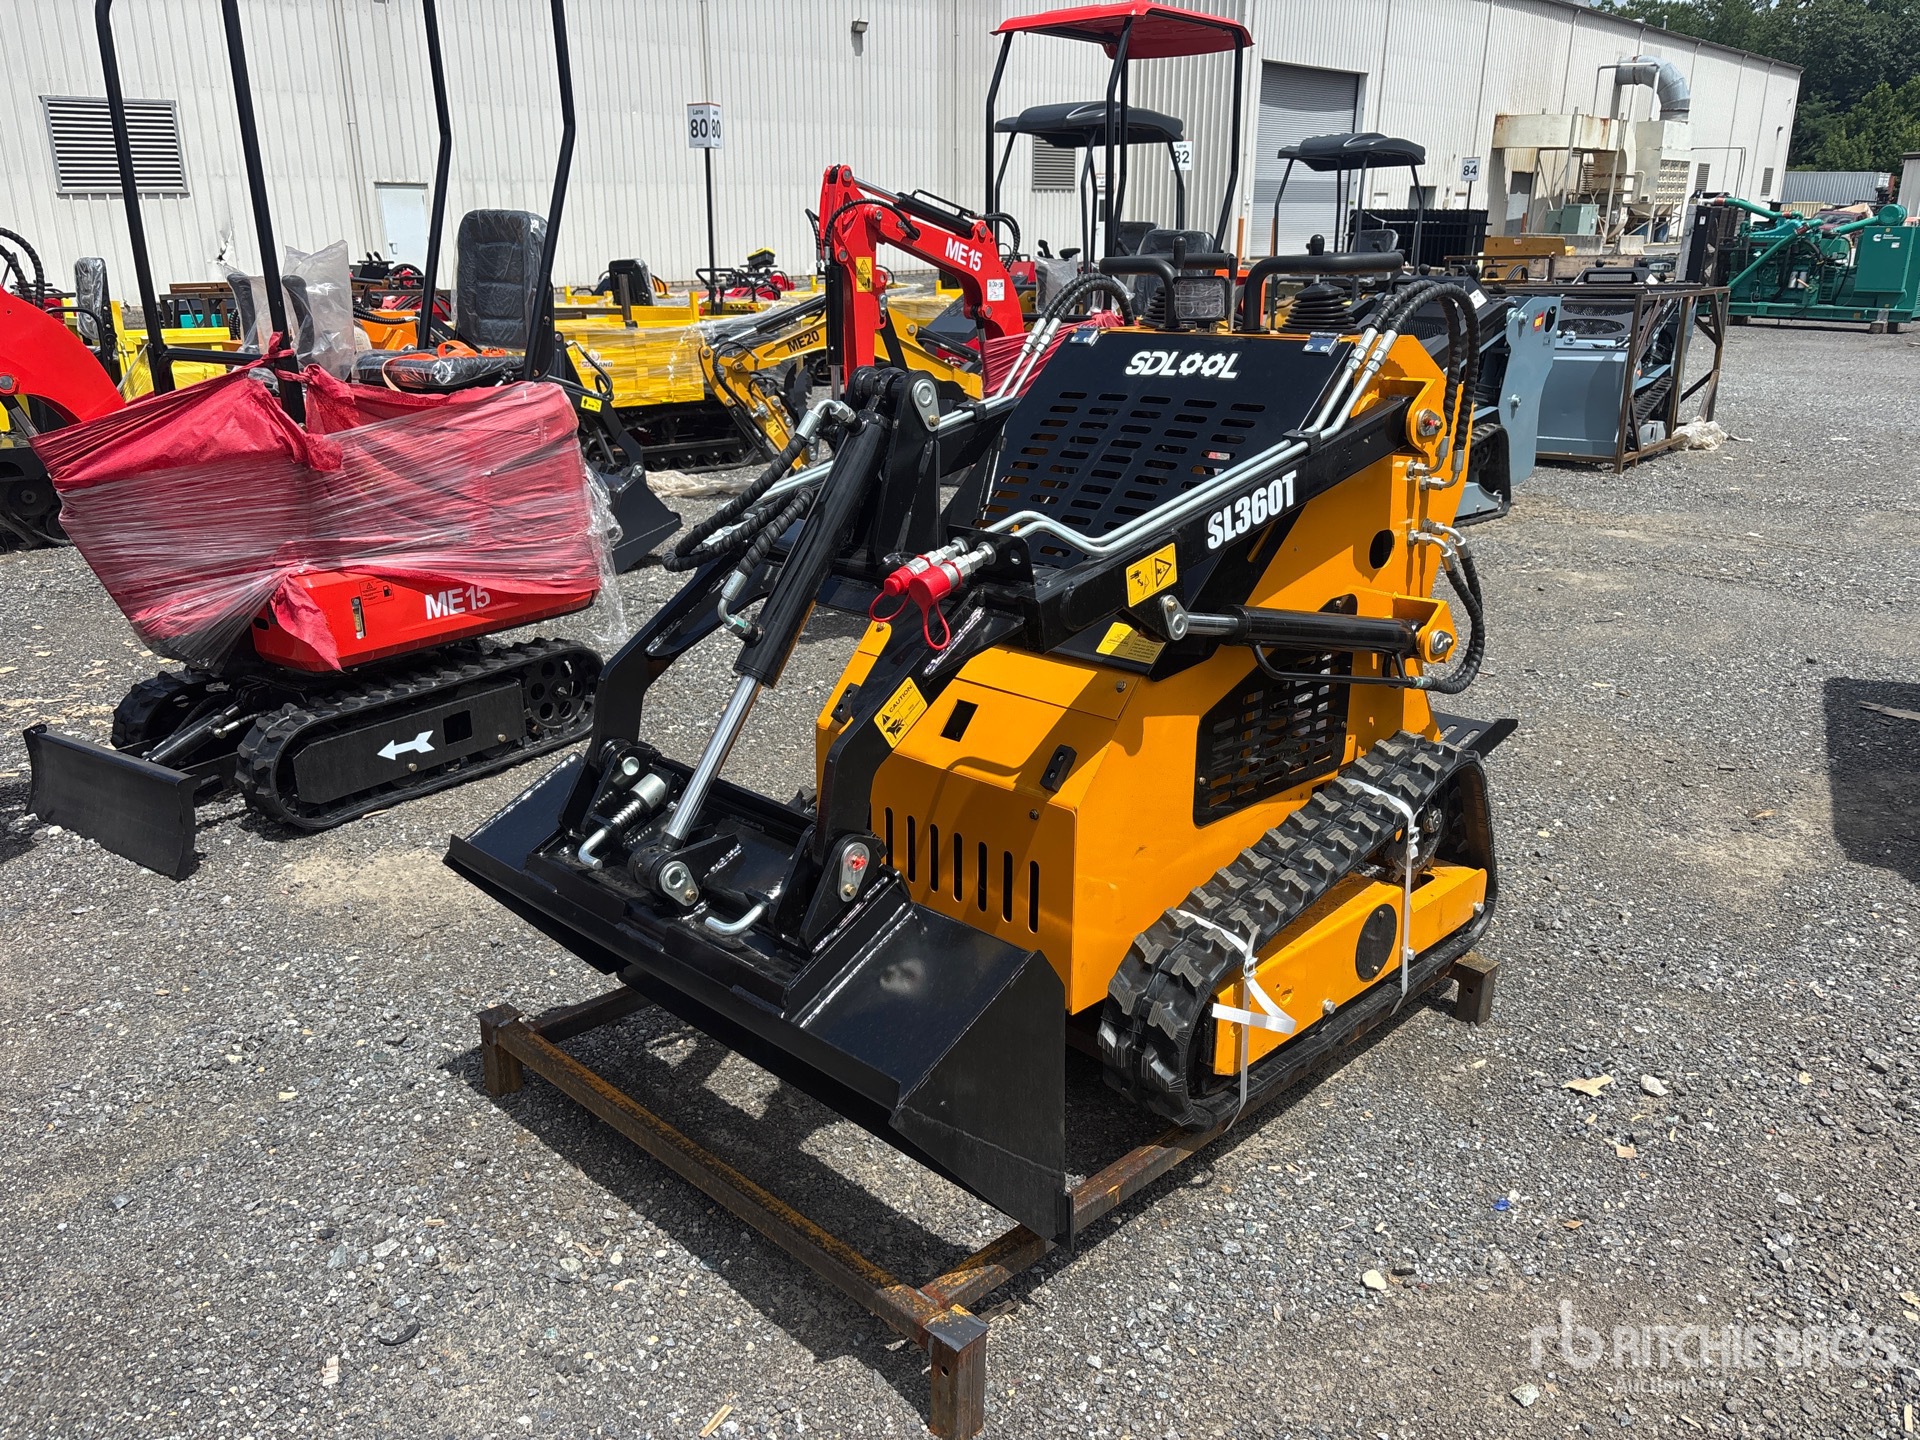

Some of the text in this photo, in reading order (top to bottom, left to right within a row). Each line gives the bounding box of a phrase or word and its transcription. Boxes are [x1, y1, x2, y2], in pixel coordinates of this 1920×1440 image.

[690, 118, 708, 139] 80
[711, 118, 721, 139] 80
[1462, 165, 1477, 176] 84
[786, 330, 820, 353] ME20
[1125, 351, 1239, 379] SDLOOL
[1206, 469, 1297, 550] SL360T
[888, 685, 913, 713] CAUTION
